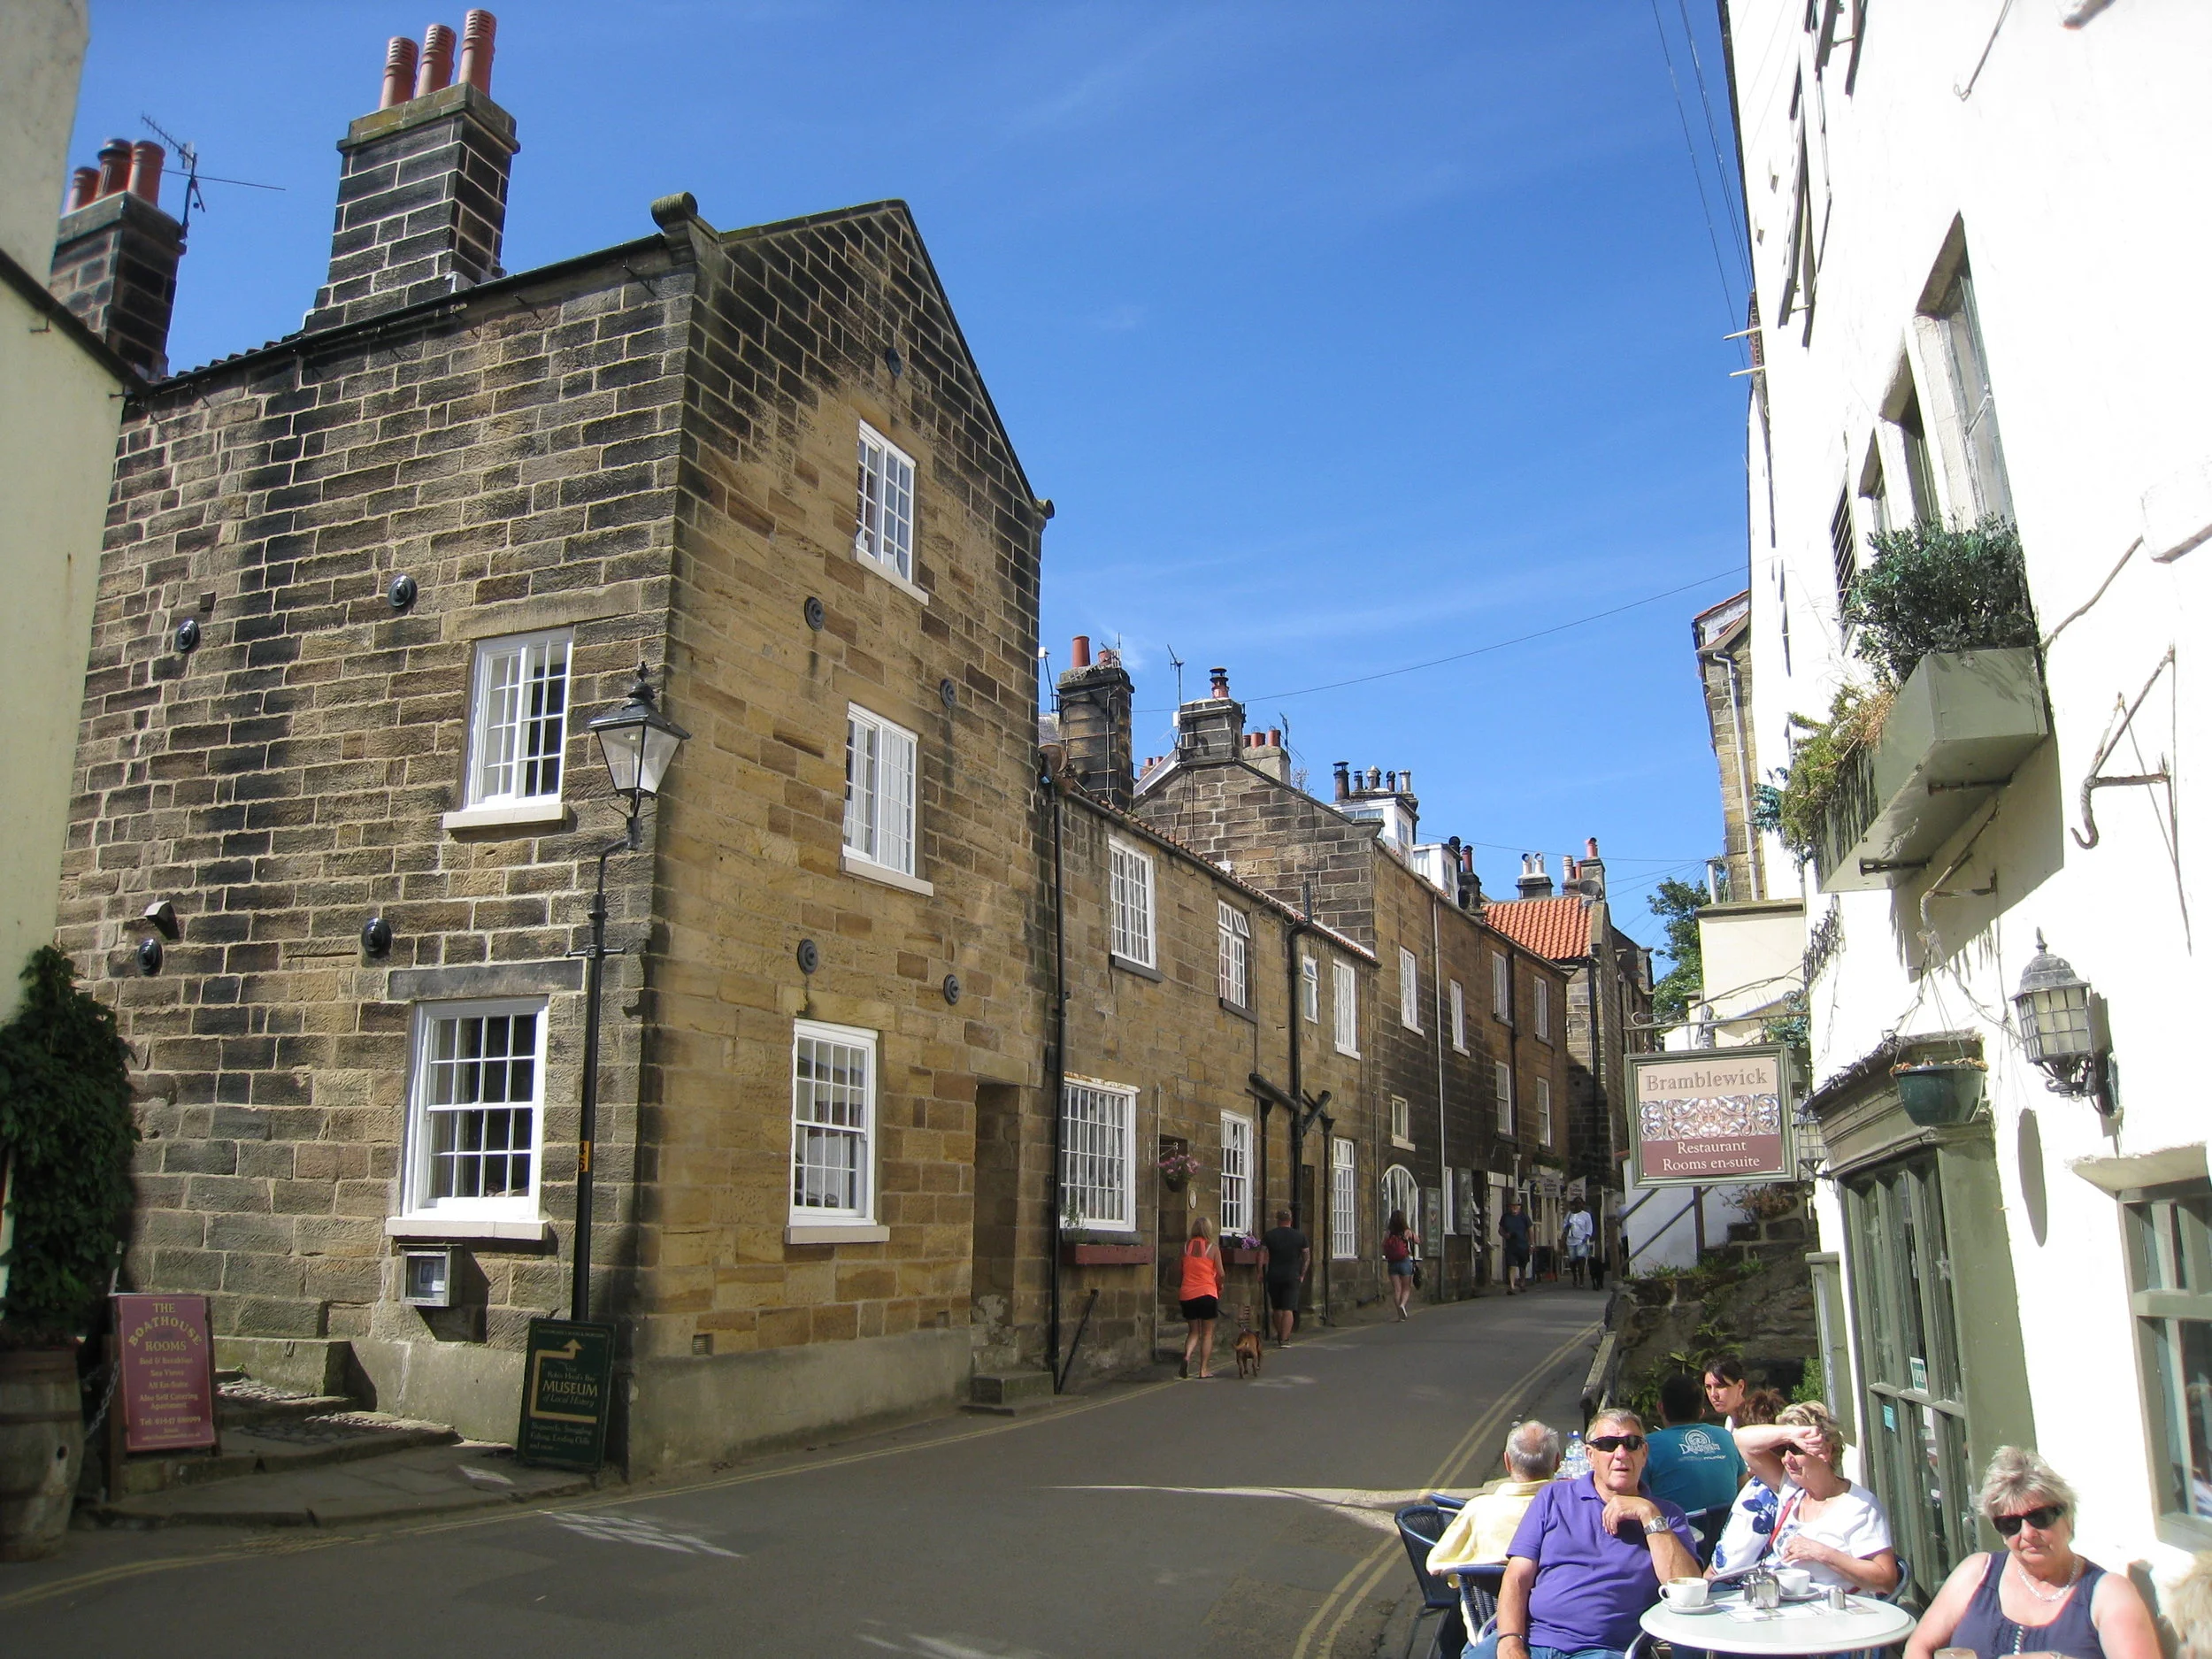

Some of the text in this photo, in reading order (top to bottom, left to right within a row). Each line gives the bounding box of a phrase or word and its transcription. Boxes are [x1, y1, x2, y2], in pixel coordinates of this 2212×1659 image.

[1647, 1068, 1767, 1091] Bramblewick
[1677, 1141, 1747, 1155] Restaurant
[1663, 1156, 1761, 1171] Rooms en-suite
[153, 1303, 175, 1313] THE
[129, 1317, 202, 1346] BOATHOUSE
[145, 1340, 188, 1352] ROOMS
[542, 1379, 597, 1396] MUSEUM
[571, 1396, 595, 1408] History
